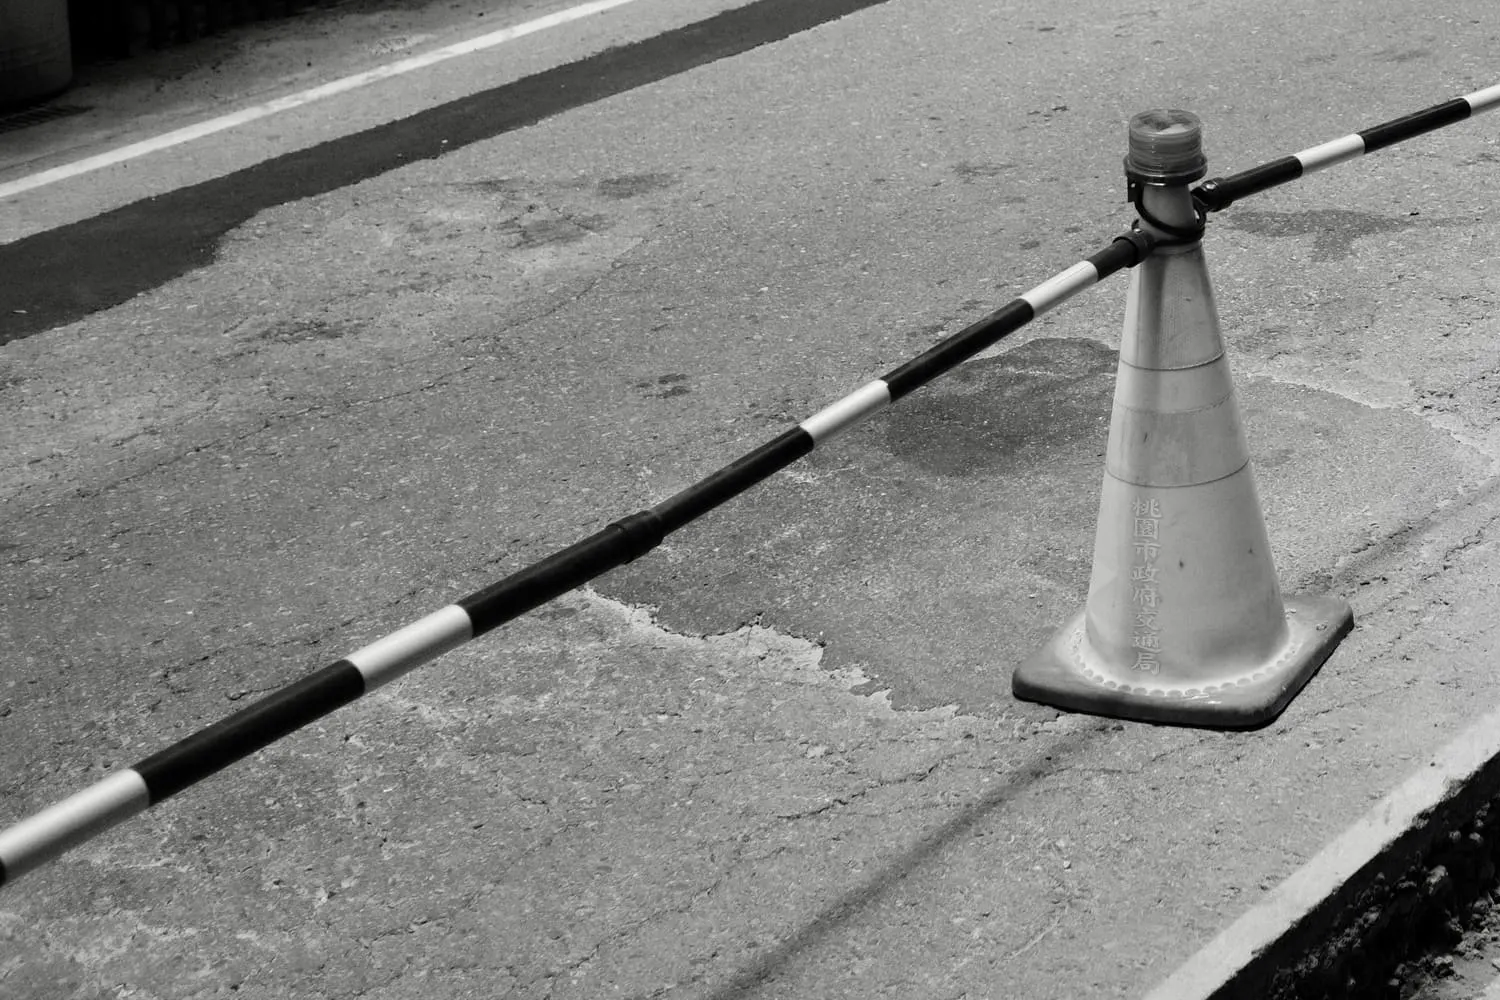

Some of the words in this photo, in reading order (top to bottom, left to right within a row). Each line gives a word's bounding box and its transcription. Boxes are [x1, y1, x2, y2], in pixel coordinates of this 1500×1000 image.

[1131, 496, 1163, 676] 桃園市政府交通局
